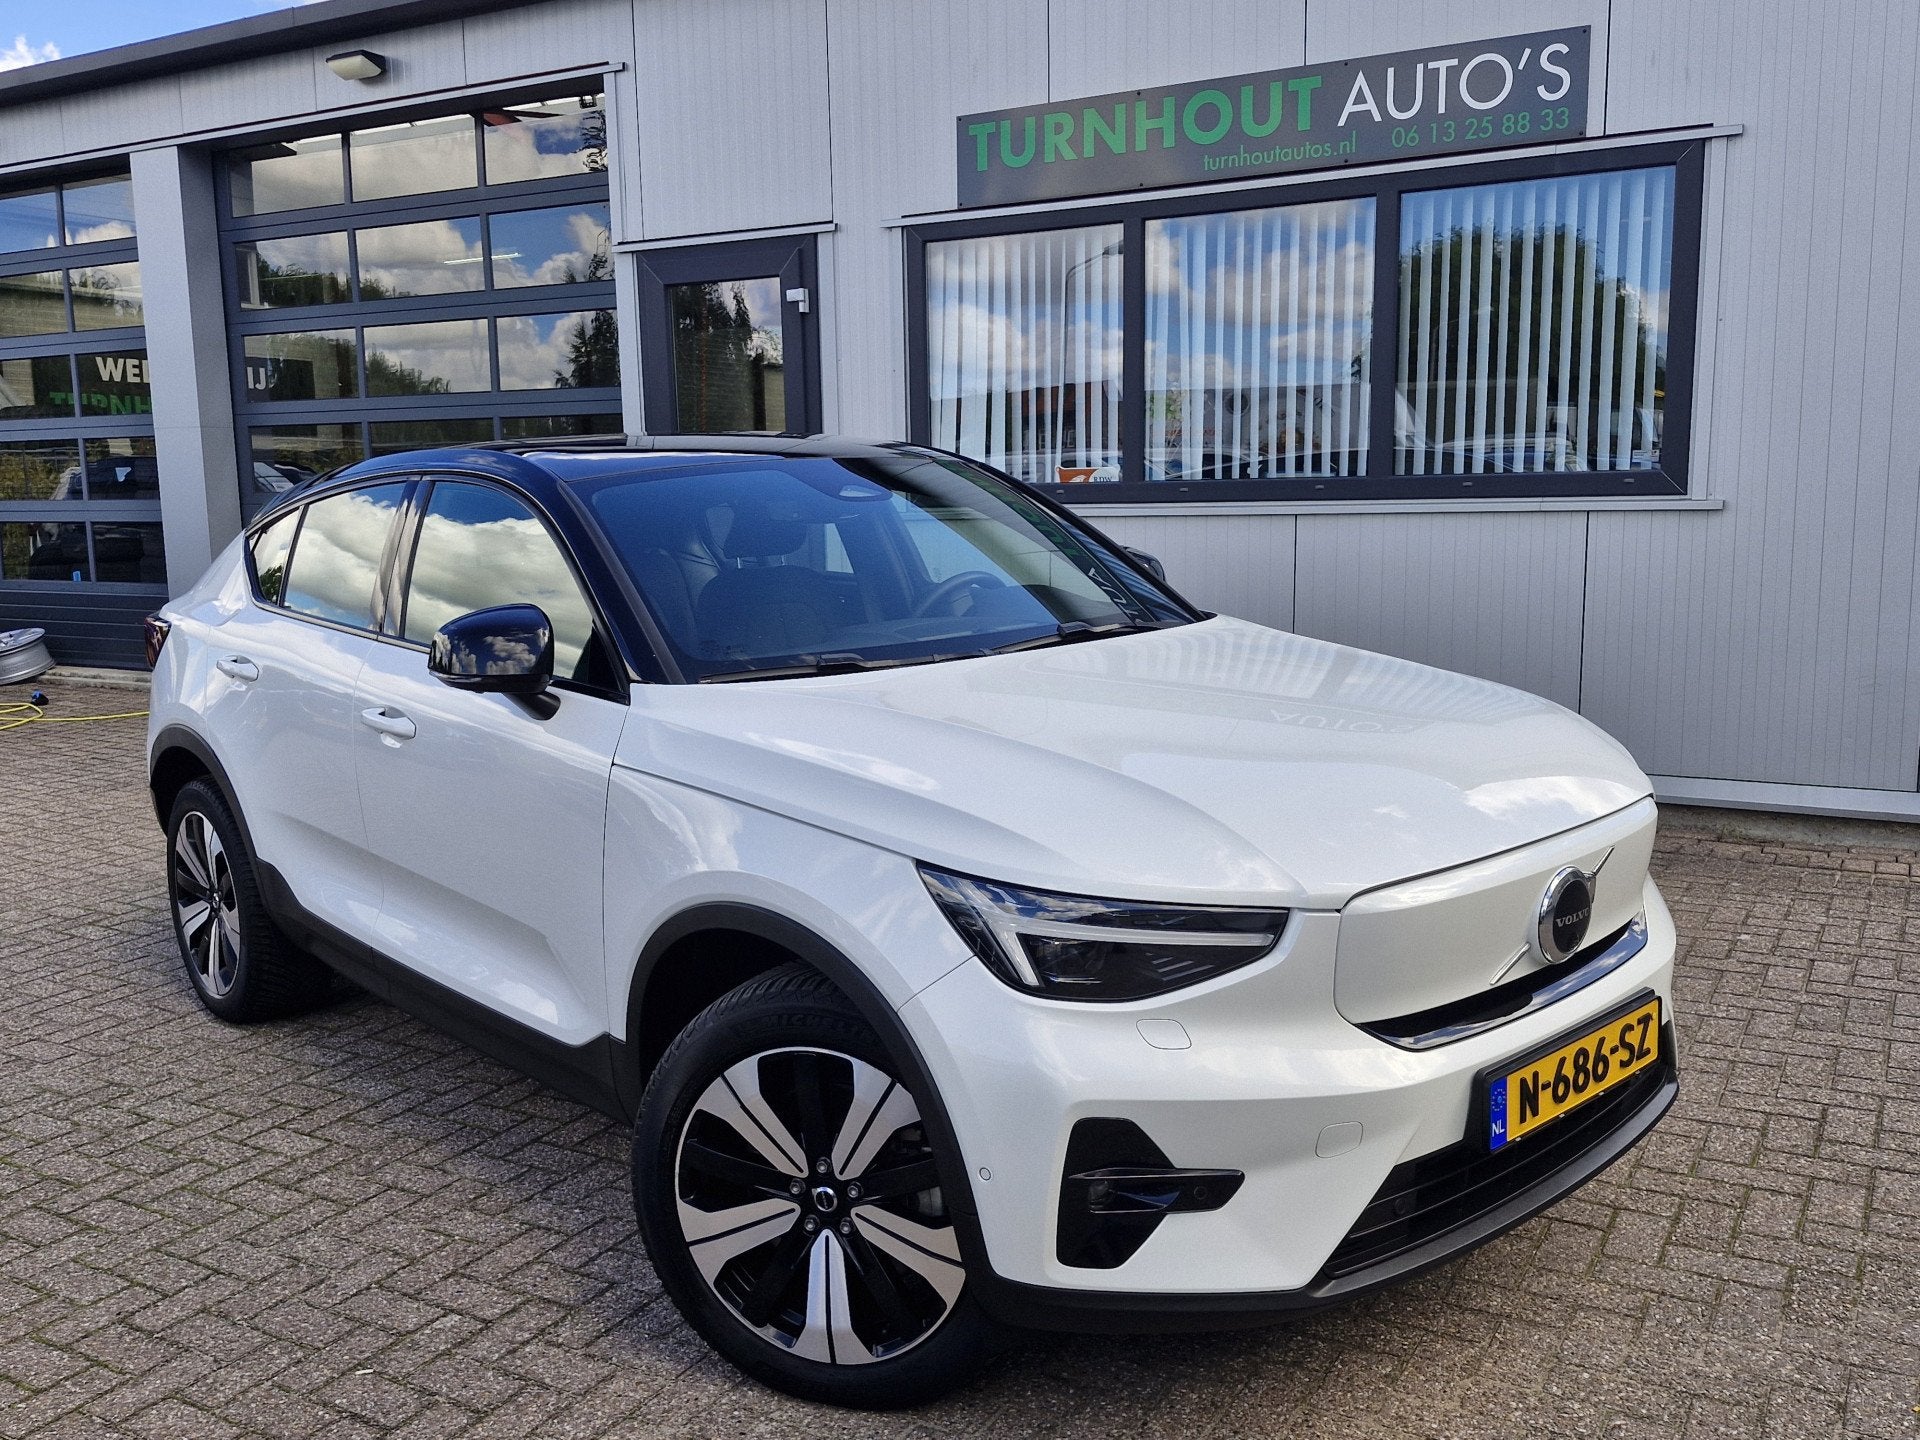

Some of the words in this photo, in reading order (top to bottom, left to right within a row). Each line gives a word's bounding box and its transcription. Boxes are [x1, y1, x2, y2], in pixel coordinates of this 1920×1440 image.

[968, 75, 1322, 172] TURNHOUT
[1337, 43, 1571, 127] AUTO'S
[1391, 127, 1420, 148] 06
[1431, 122, 1456, 144] 13
[1465, 116, 1493, 140] 25
[1502, 111, 1530, 135] 88
[1541, 107, 1569, 131] 33
[1203, 131, 1357, 171] turnhoutautos.nl
[1519, 1012, 1653, 1125] N-686-SZ
[1491, 1120, 1505, 1137] NL
